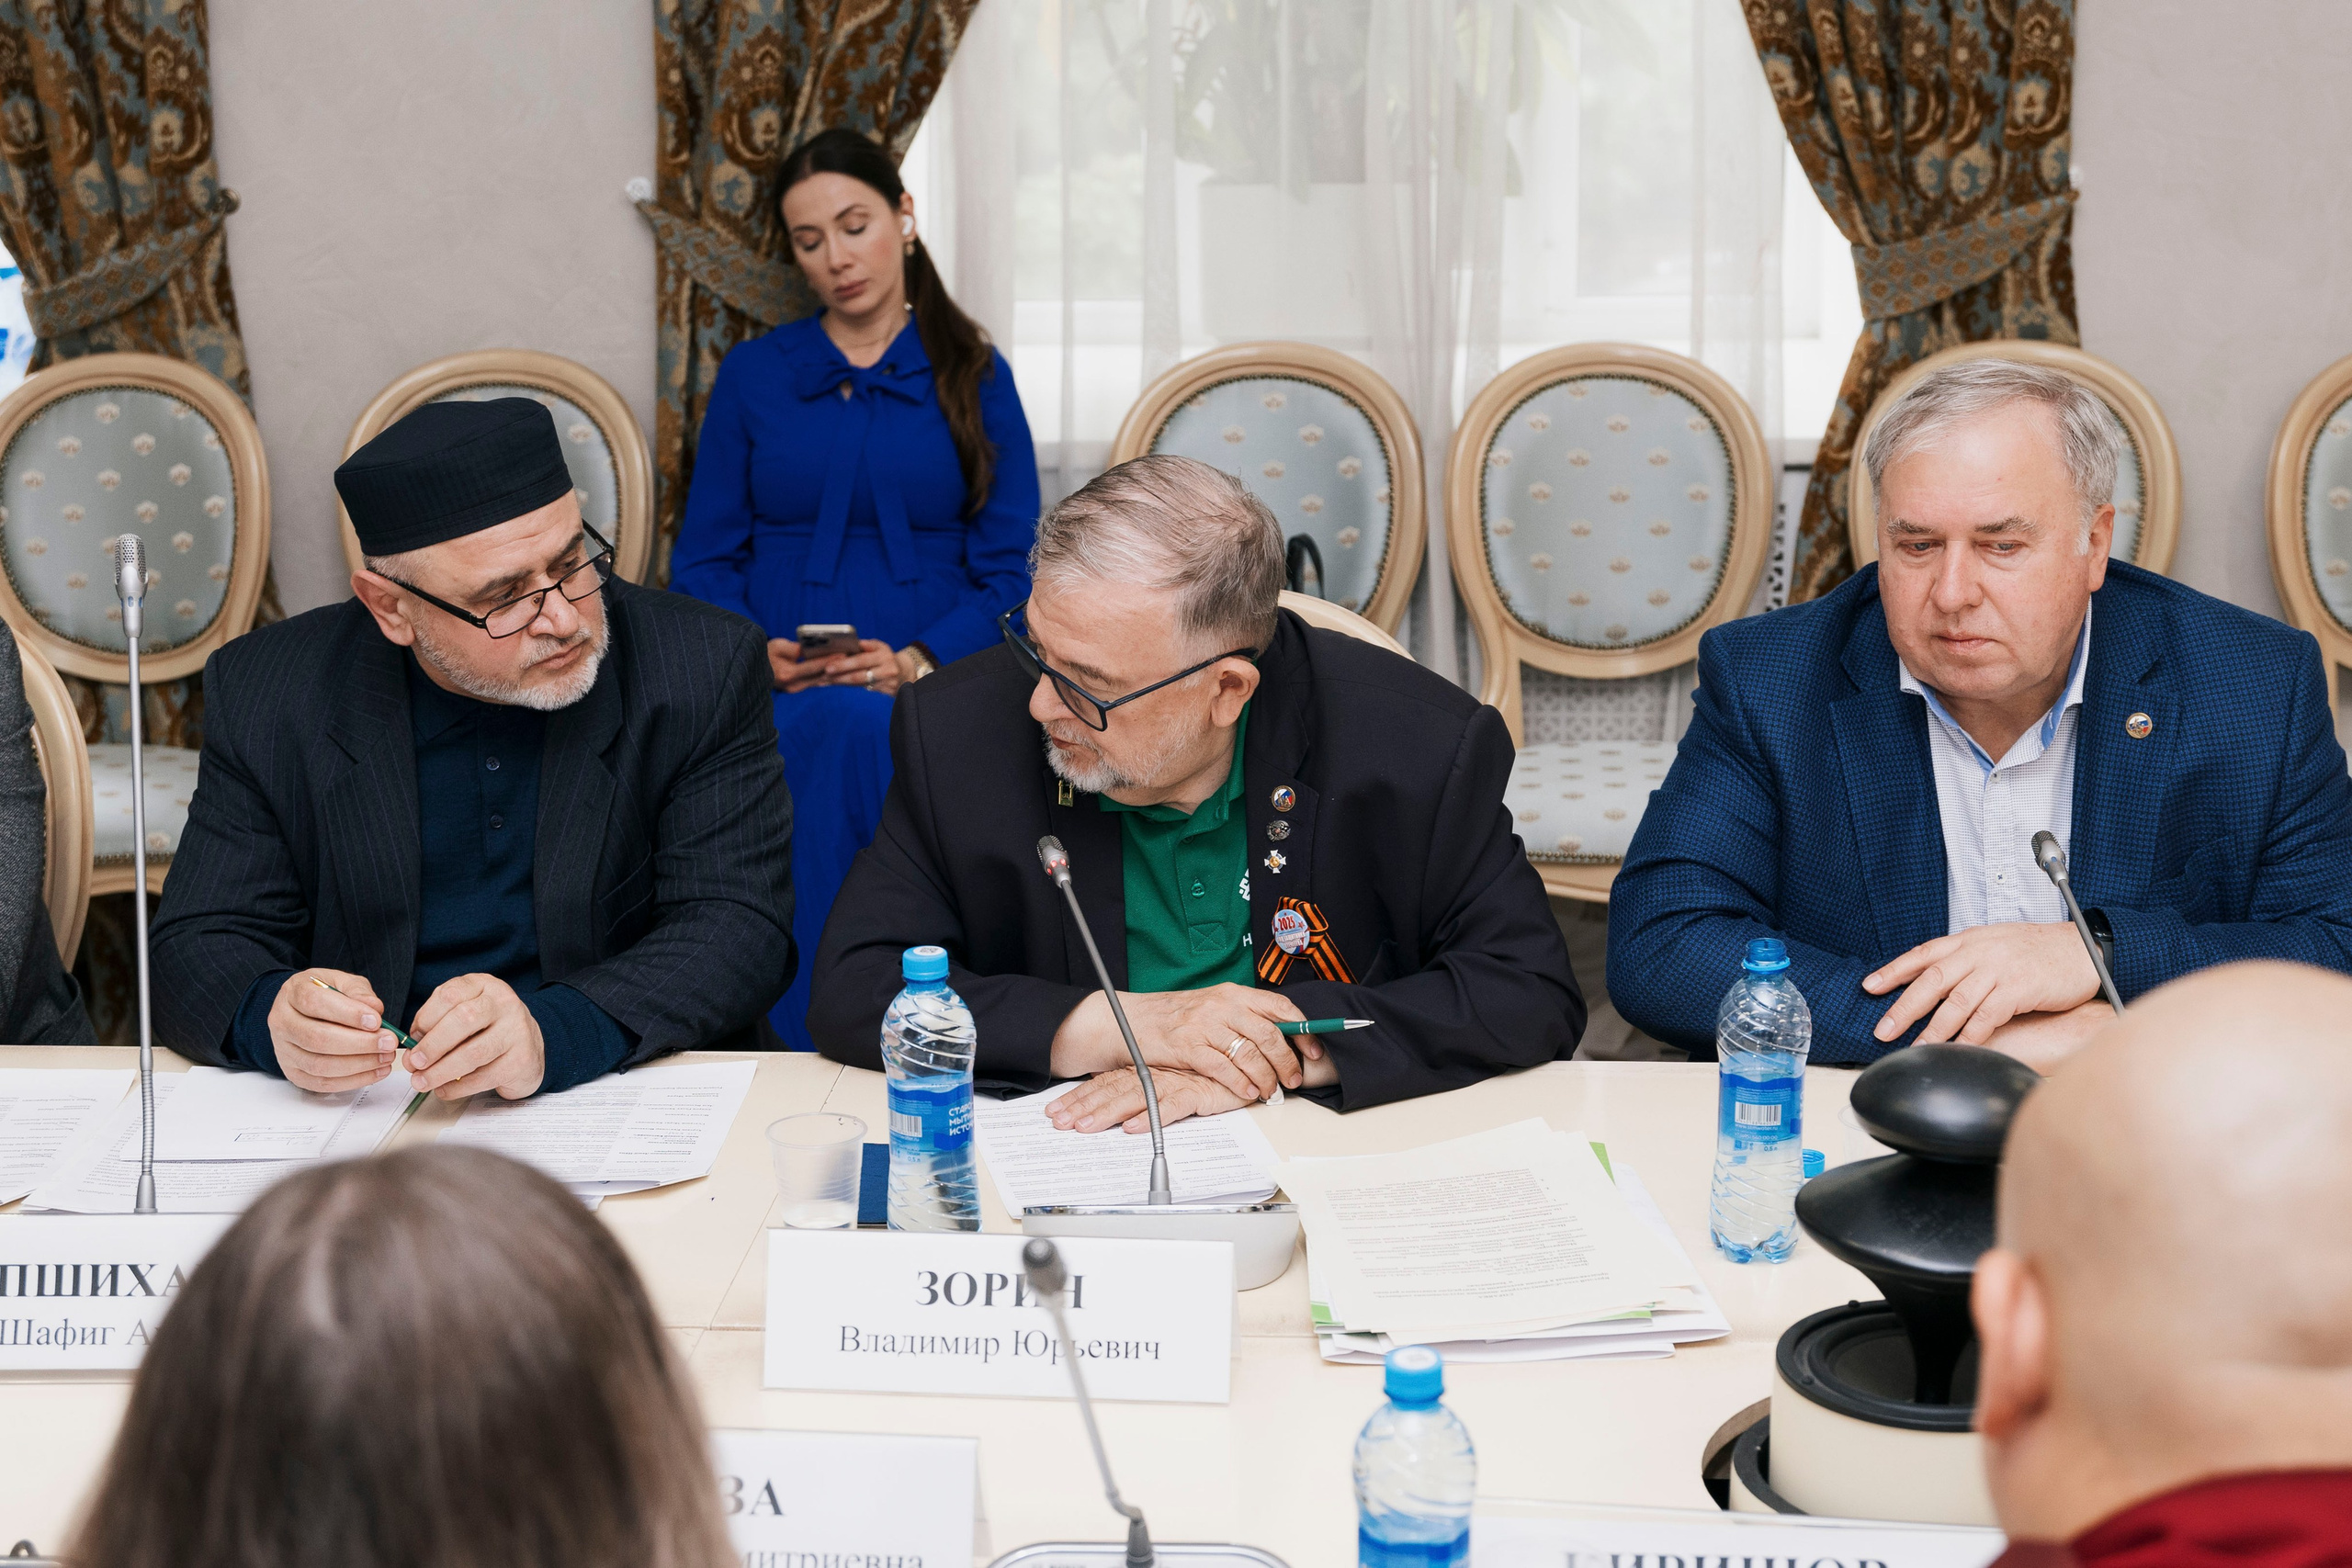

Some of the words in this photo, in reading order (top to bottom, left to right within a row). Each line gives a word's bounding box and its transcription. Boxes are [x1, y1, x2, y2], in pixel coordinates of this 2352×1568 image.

[1278, 916, 1296, 931] 2025
[0, 1318, 116, 1350] Шафиг
[125, 1318, 159, 1346] А
[840, 1325, 1001, 1364] Владимир
[1013, 1329, 1161, 1366] Юрьевич
